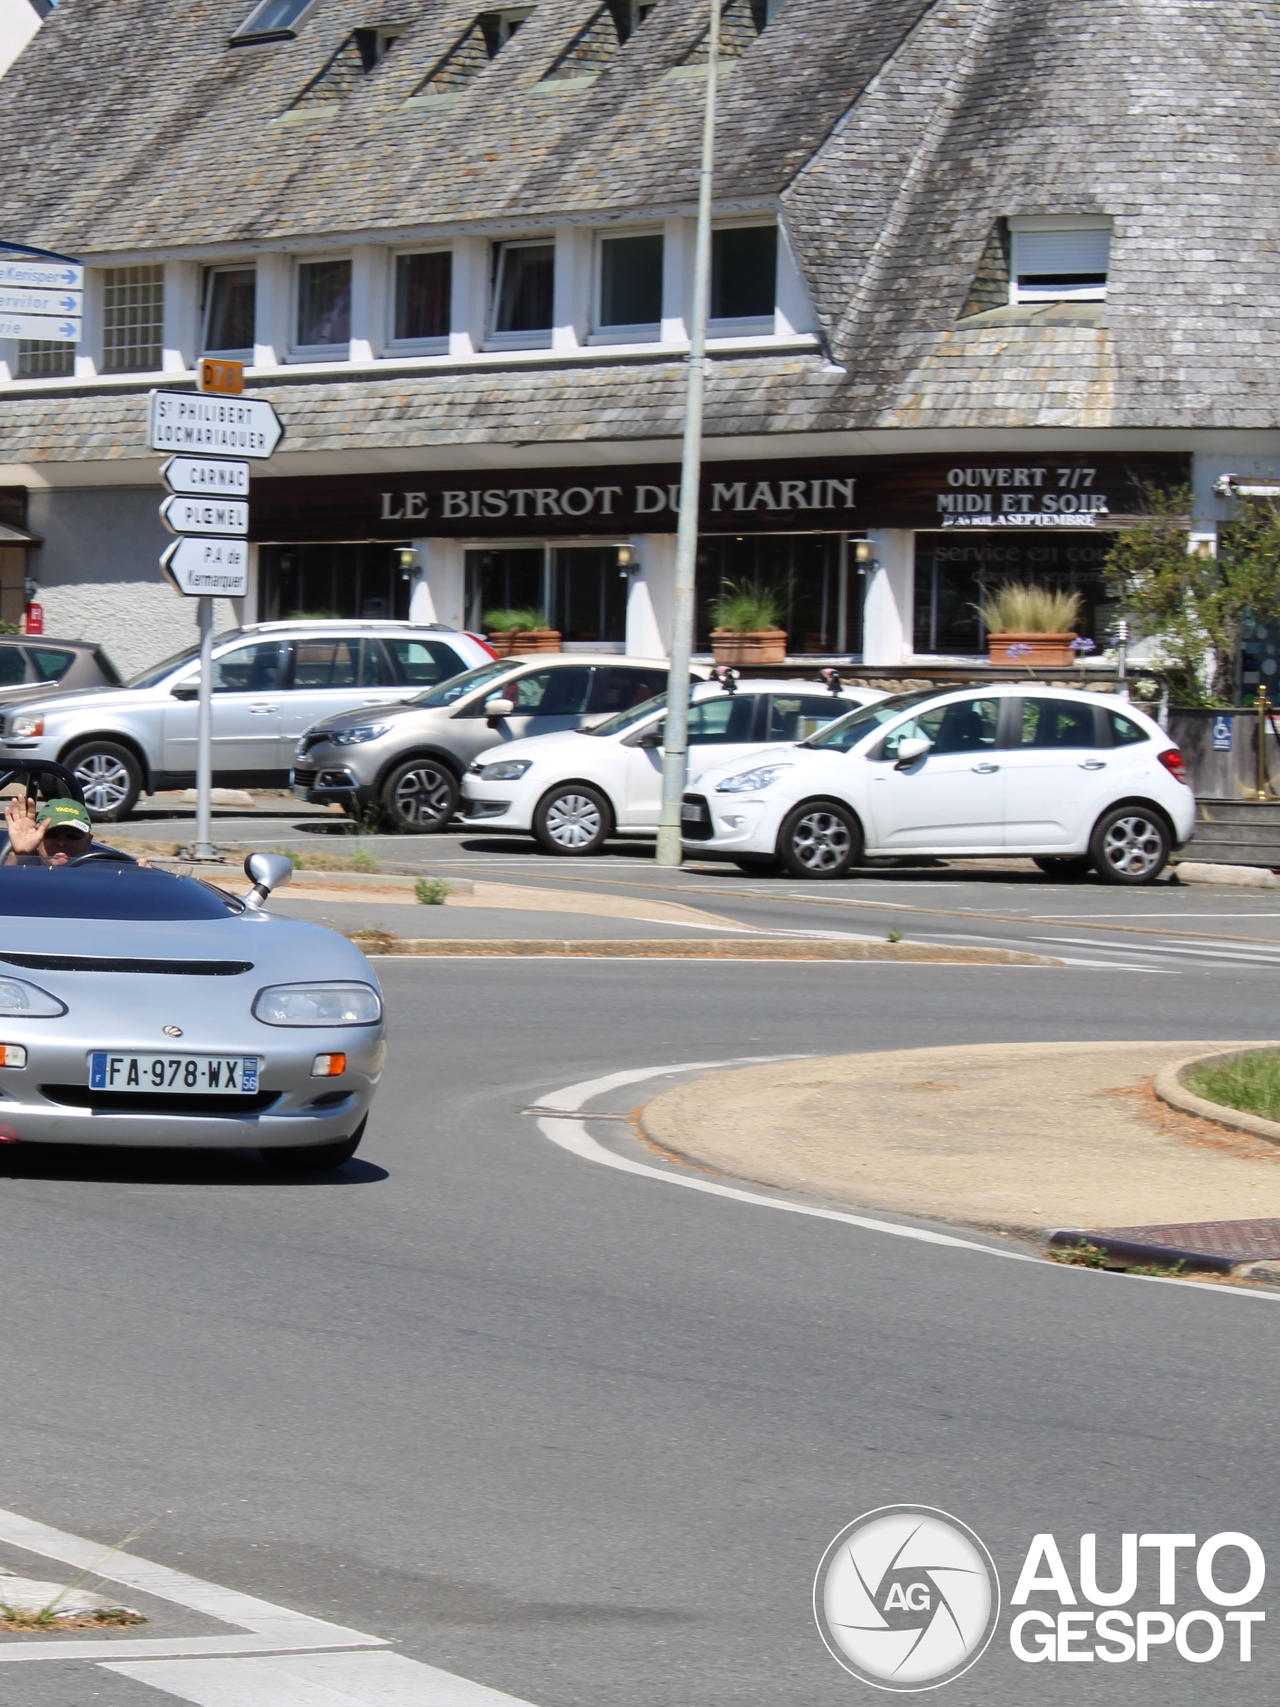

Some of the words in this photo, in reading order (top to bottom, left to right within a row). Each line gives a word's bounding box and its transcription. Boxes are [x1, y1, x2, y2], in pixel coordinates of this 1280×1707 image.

[178, 402, 254, 425] PHILIBERT
[156, 424, 267, 450] LOCMARIAQUER
[189, 467, 245, 487] CARNAC
[947, 468, 1047, 487] OUVERT
[1056, 468, 1097, 488] 7/7
[380, 491, 429, 520] LE
[441, 485, 624, 519] BISTROT
[710, 478, 857, 511] MARIN
[936, 493, 992, 513] MIDI
[1001, 494, 1036, 513] ET
[1040, 493, 1110, 513] SOIR
[227, 548, 241, 566] de
[186, 569, 245, 593] Kermarquer
[55, 806, 80, 816] YACCO
[109, 1058, 238, 1089] FA-978-WX
[242, 1076, 257, 1090] 56
